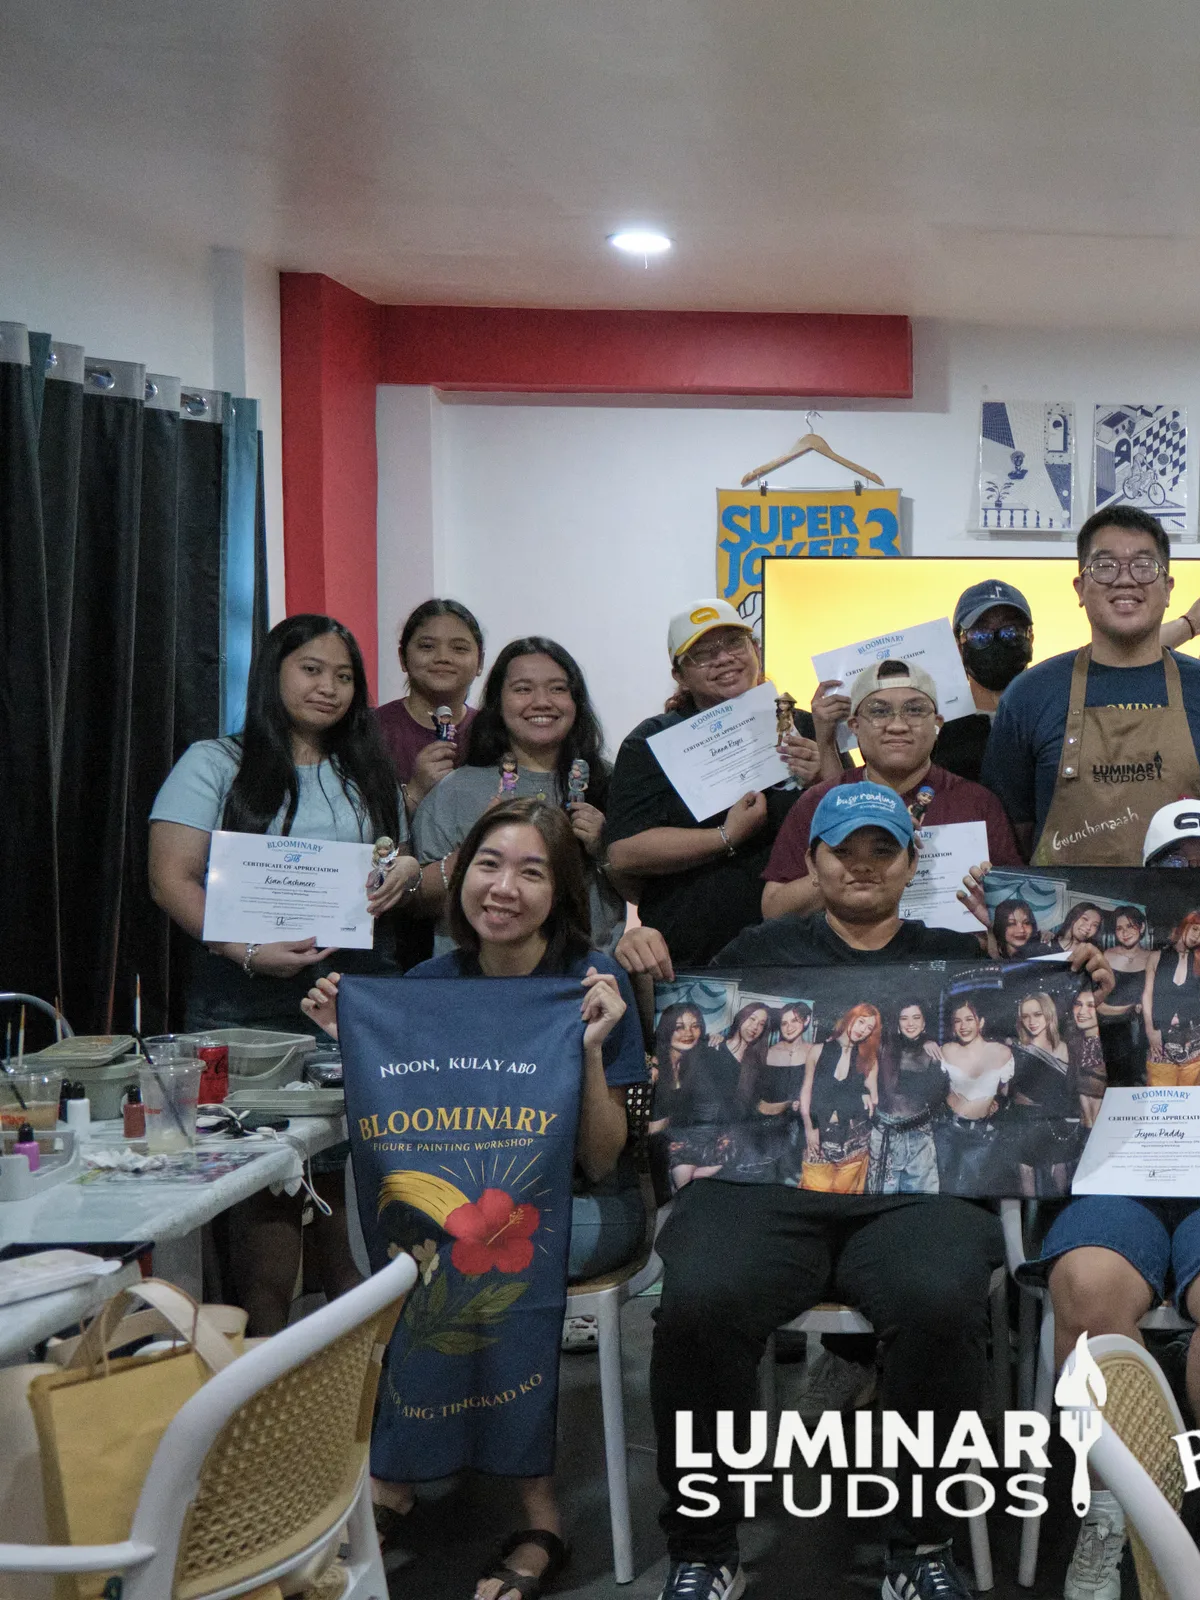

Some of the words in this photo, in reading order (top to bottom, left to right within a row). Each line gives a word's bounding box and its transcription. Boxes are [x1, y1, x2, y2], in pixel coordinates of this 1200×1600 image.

[719, 505, 860, 551] SUPER
[858, 635, 905, 655] BLOOMINARY
[691, 705, 733, 730] BLOOMINARY
[1093, 773, 1154, 783] STUDIOS
[267, 840, 323, 852] BLOOMINARY
[243, 861, 282, 869] CERTIFICATE
[294, 865, 339, 873] APPRECIATION
[380, 1059, 440, 1078] NOON,
[449, 1057, 504, 1071] KULAY
[506, 1062, 537, 1075] ABO
[1131, 1089, 1190, 1101] BLOOMINARY
[358, 1106, 558, 1141] BLOOMINARY
[373, 1142, 412, 1152] FIGURE
[417, 1143, 470, 1151] PAINTING
[475, 1138, 534, 1150] WORKSHOP
[402, 1405, 434, 1419] ANG
[441, 1389, 516, 1417] TINGKAD
[519, 1373, 543, 1394] KO
